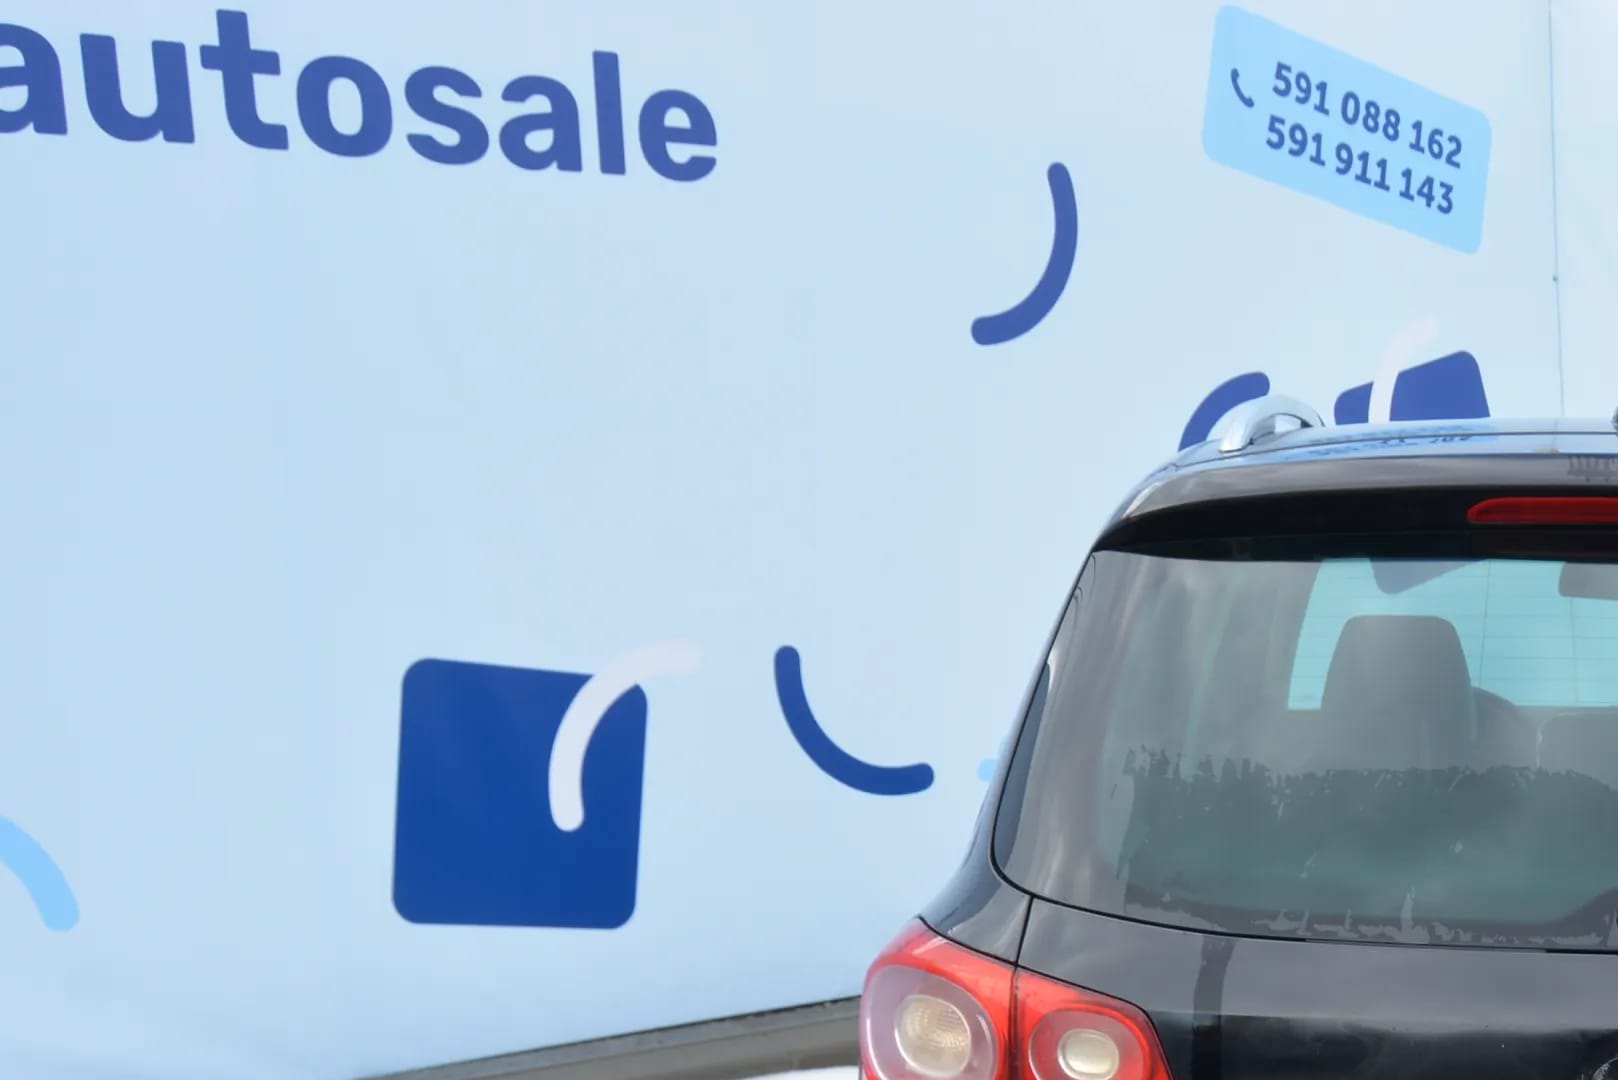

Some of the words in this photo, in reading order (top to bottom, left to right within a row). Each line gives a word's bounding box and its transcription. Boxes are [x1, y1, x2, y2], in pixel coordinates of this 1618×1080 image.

[0, 9, 718, 183] autosale
[1272, 61, 1331, 117] 591
[1340, 90, 1401, 143] 088
[1408, 119, 1463, 170] 162
[1265, 113, 1326, 168] 591
[1334, 141, 1391, 193] 911
[1398, 167, 1454, 215] 143
